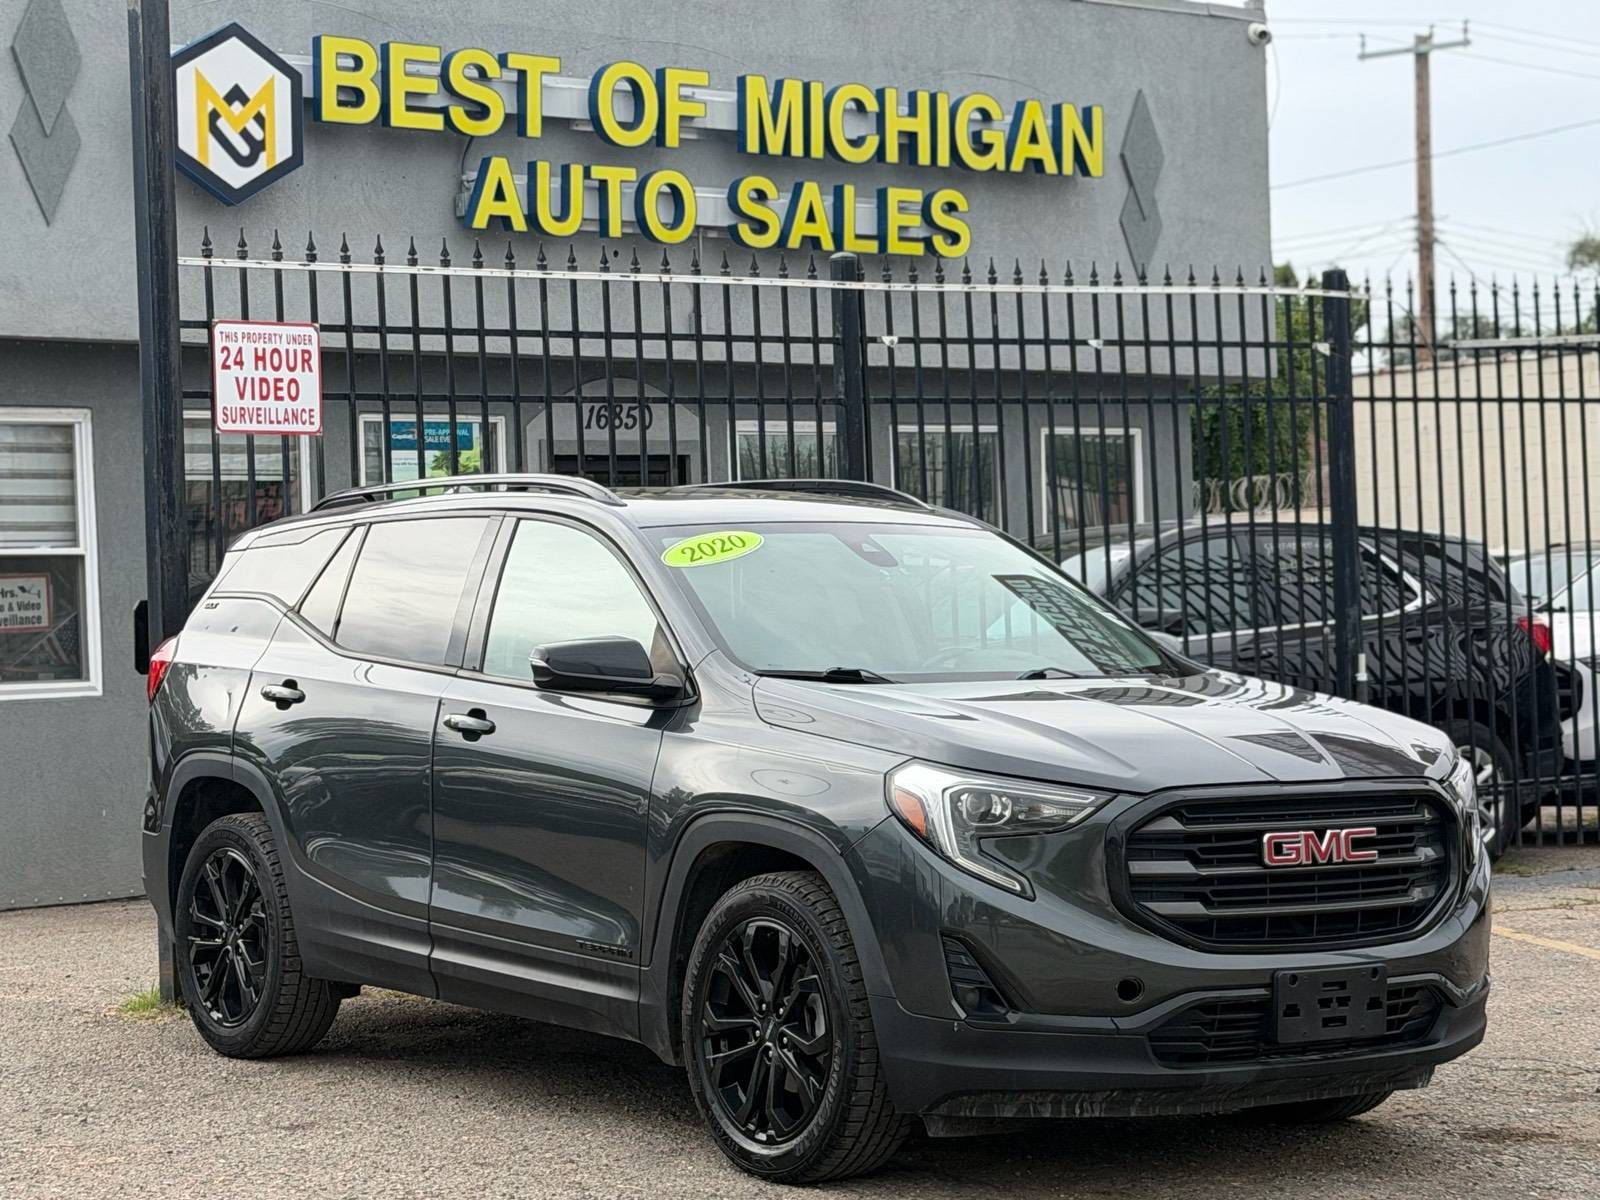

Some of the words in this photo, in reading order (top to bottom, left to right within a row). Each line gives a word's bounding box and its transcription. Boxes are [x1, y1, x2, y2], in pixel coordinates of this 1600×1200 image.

[315, 35, 561, 136] BEST
[593, 61, 709, 148] OF
[740, 74, 1104, 177] MICHIGAN
[468, 156, 697, 243] AUTO
[730, 176, 971, 258] SALES
[219, 330, 239, 343] THIS
[241, 331, 283, 345] PROPERTY
[286, 333, 313, 346] UNDER
[220, 345, 245, 371] 24
[254, 346, 314, 373] HOUR
[234, 376, 300, 402] VIDEO
[222, 405, 316, 426] SURVEILLANCE
[680, 534, 747, 563] 2020
[16, 600, 42, 611] Video
[1262, 826, 1379, 866] GMC
